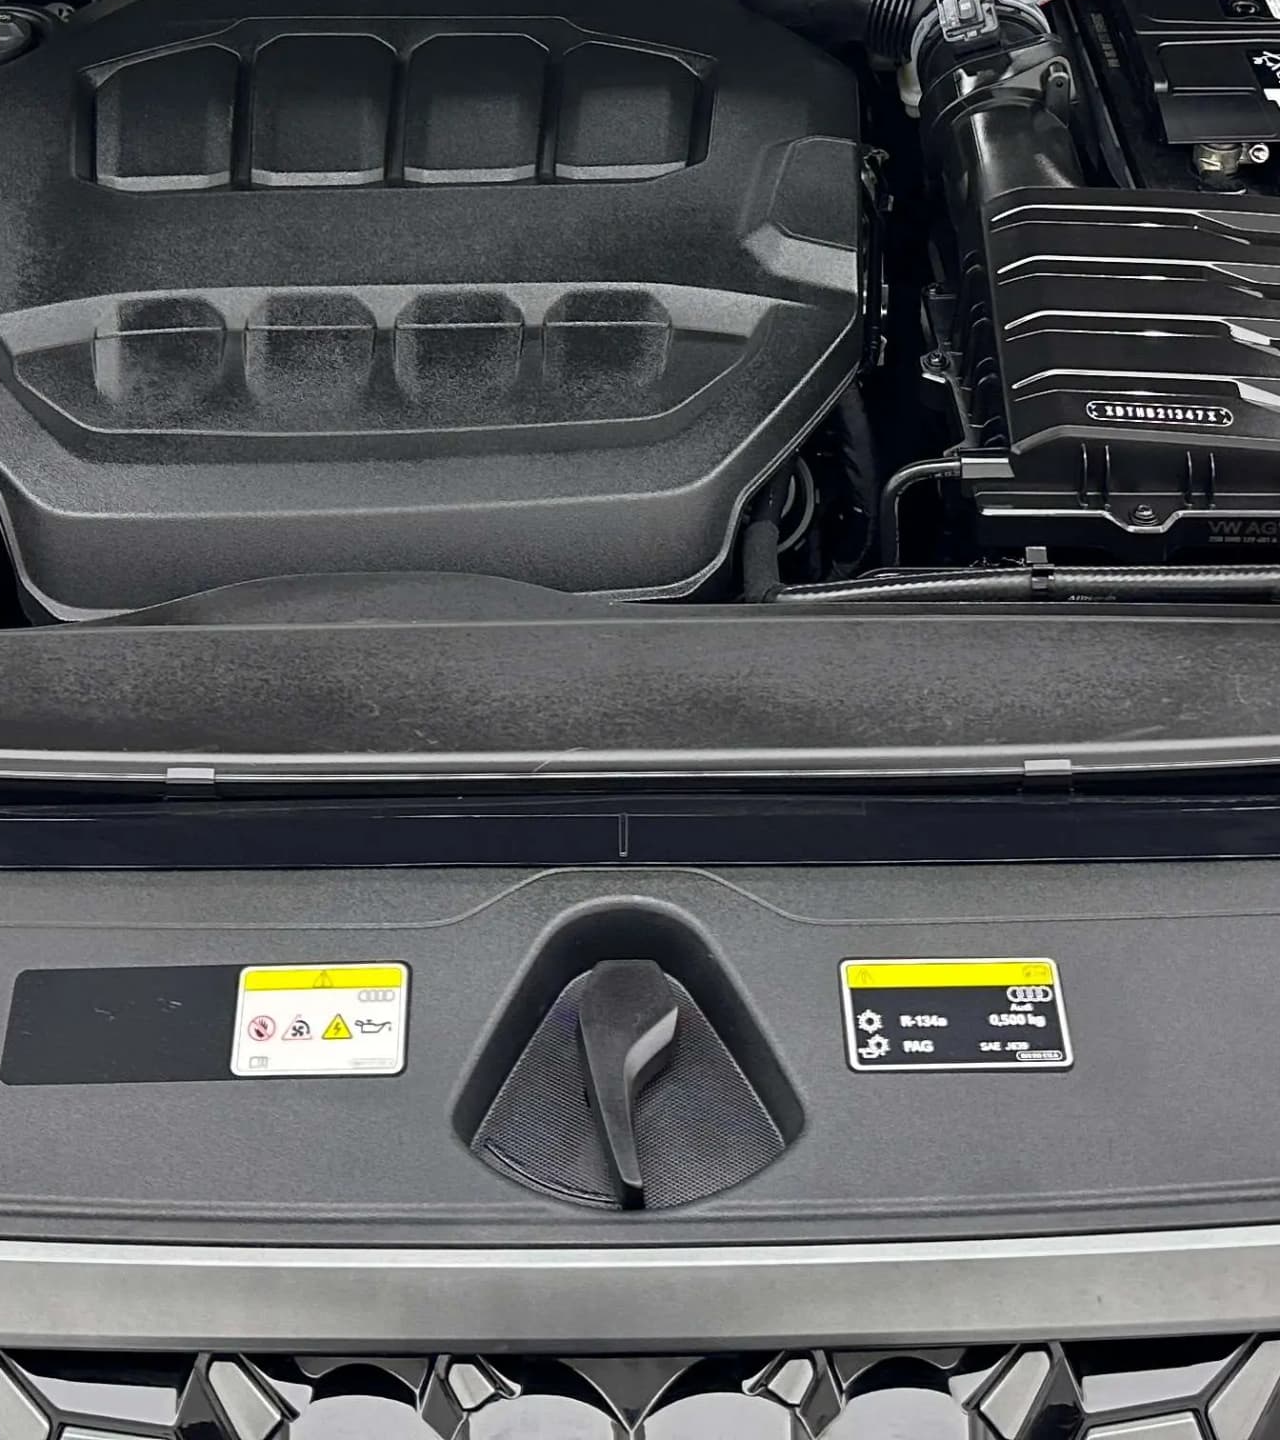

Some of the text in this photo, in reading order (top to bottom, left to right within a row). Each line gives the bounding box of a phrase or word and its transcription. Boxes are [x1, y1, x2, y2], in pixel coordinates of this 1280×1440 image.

[1208, 521, 1242, 535] VW
[1246, 521, 1277, 535] AG
[899, 1014, 949, 1028] R-134a
[903, 1039, 935, 1053] PAG
